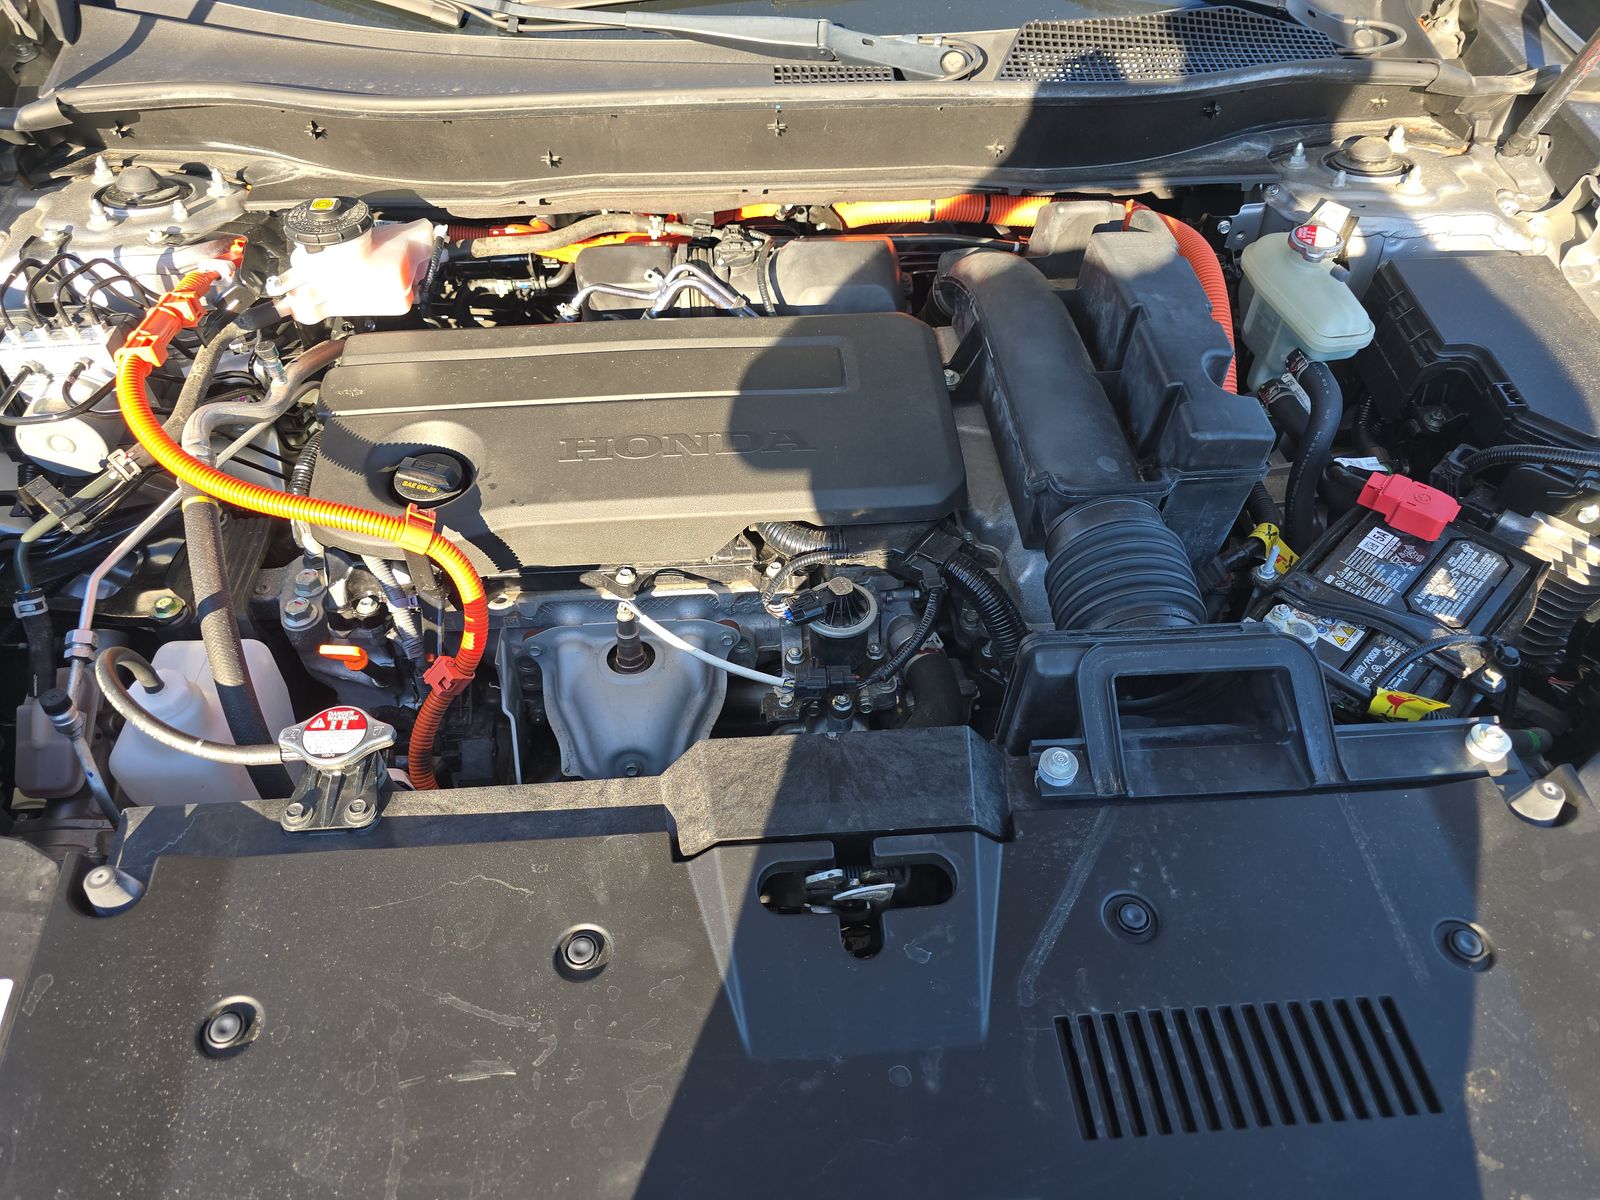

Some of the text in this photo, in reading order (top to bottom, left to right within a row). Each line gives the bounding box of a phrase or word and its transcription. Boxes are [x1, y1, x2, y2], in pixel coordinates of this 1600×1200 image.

[558, 432, 816, 462] HONDA
[401, 480, 438, 494] SAE 0W-20
[1372, 530, 1390, 542] 5A
